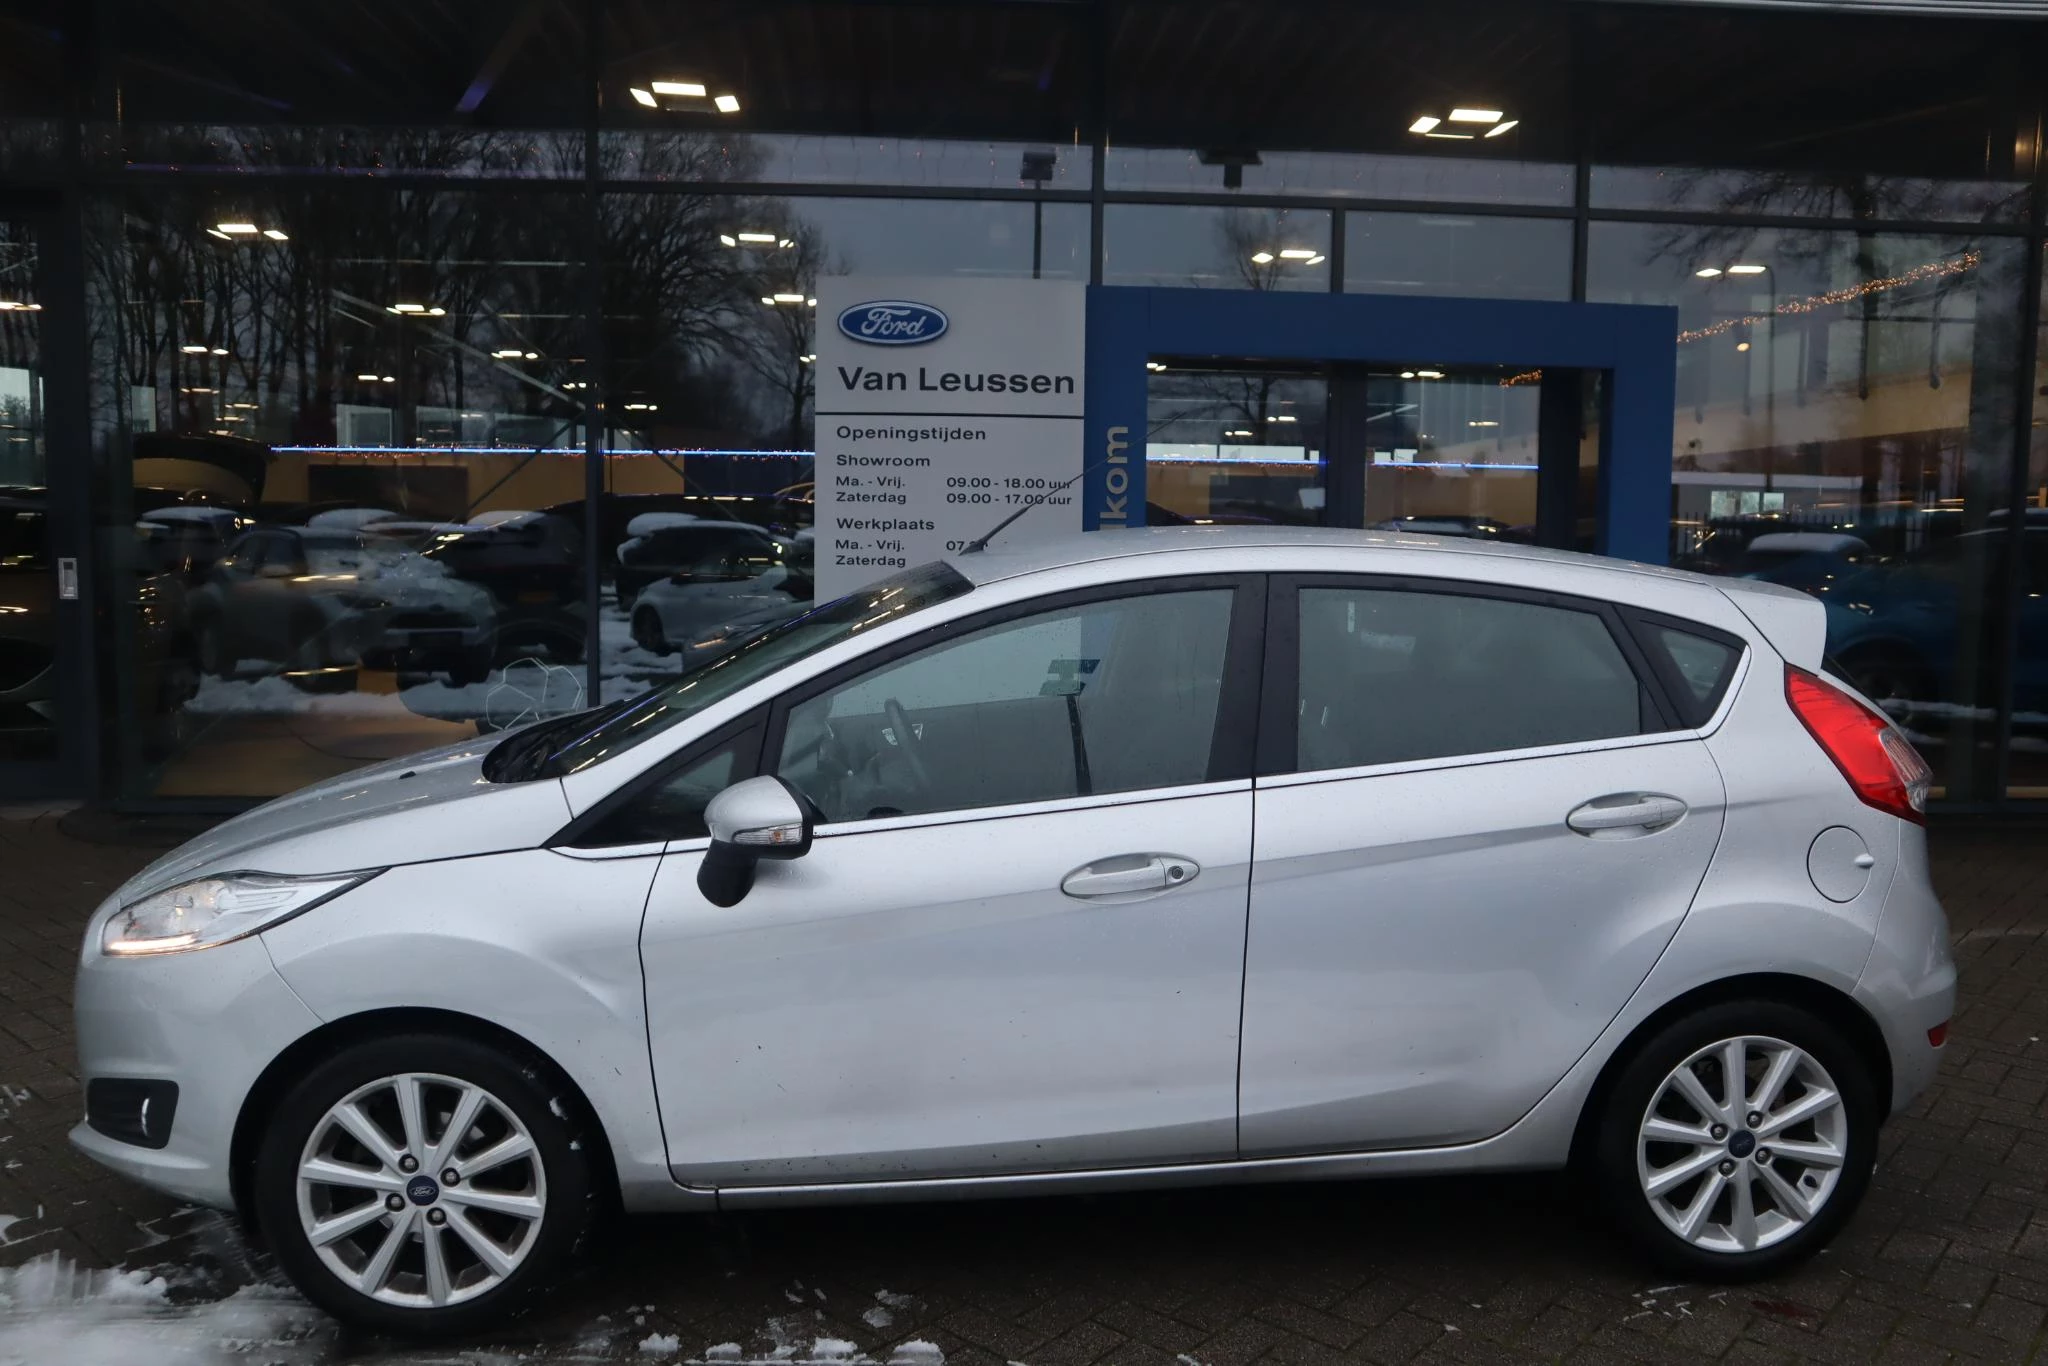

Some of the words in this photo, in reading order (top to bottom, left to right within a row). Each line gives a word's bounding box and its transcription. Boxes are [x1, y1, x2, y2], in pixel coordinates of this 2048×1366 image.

[861, 307, 926, 335] Ford
[838, 366, 907, 391] Van
[919, 367, 1075, 394] Leussen
[836, 425, 986, 442] Openingstijden
[836, 454, 931, 467] Showroom
[835, 476, 864, 487] Ma.
[876, 476, 906, 489] Vrij.
[946, 477, 991, 488] 09.00
[1004, 478, 1045, 489] 18.00
[1048, 481, 1072, 489] uur
[836, 491, 907, 505] Zaterdag
[946, 493, 992, 504] 09.00
[1004, 494, 1045, 505] 17.00
[1048, 495, 1072, 505] uur
[836, 518, 935, 532] Werkplaats
[835, 540, 863, 550] Ma.
[876, 540, 905, 552] Vrij.
[835, 555, 906, 568] Zaterdag
